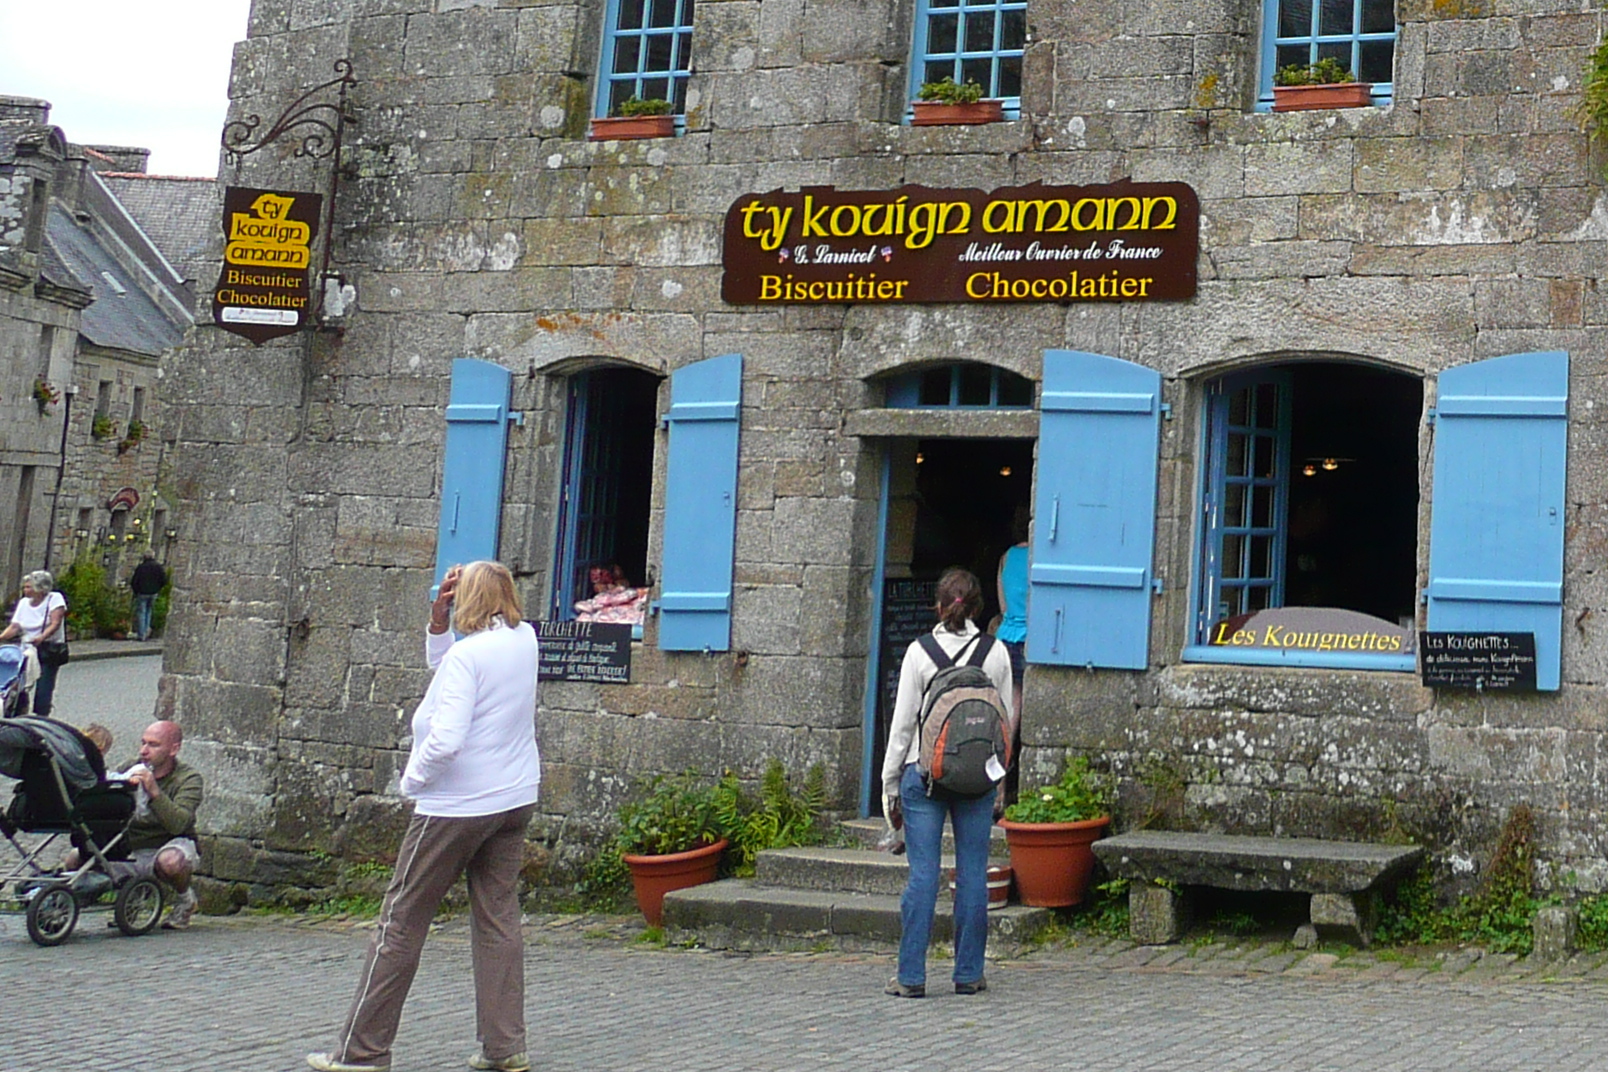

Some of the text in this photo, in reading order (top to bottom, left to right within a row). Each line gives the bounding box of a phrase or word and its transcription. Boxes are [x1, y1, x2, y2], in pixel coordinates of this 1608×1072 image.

[262, 199, 283, 219] ty
[741, 201, 793, 250] ty
[982, 196, 1178, 233] amann
[231, 246, 303, 263] amann
[794, 244, 809, 264] G.
[958, 238, 1164, 262] Meilleur Ouvrier de France
[227, 270, 303, 288] Biscuitier
[758, 273, 909, 301] Biscuitier
[965, 270, 1154, 299] Chocolatier
[217, 289, 308, 308] Chocolatier
[1214, 622, 1402, 652] Les Kouignettes
